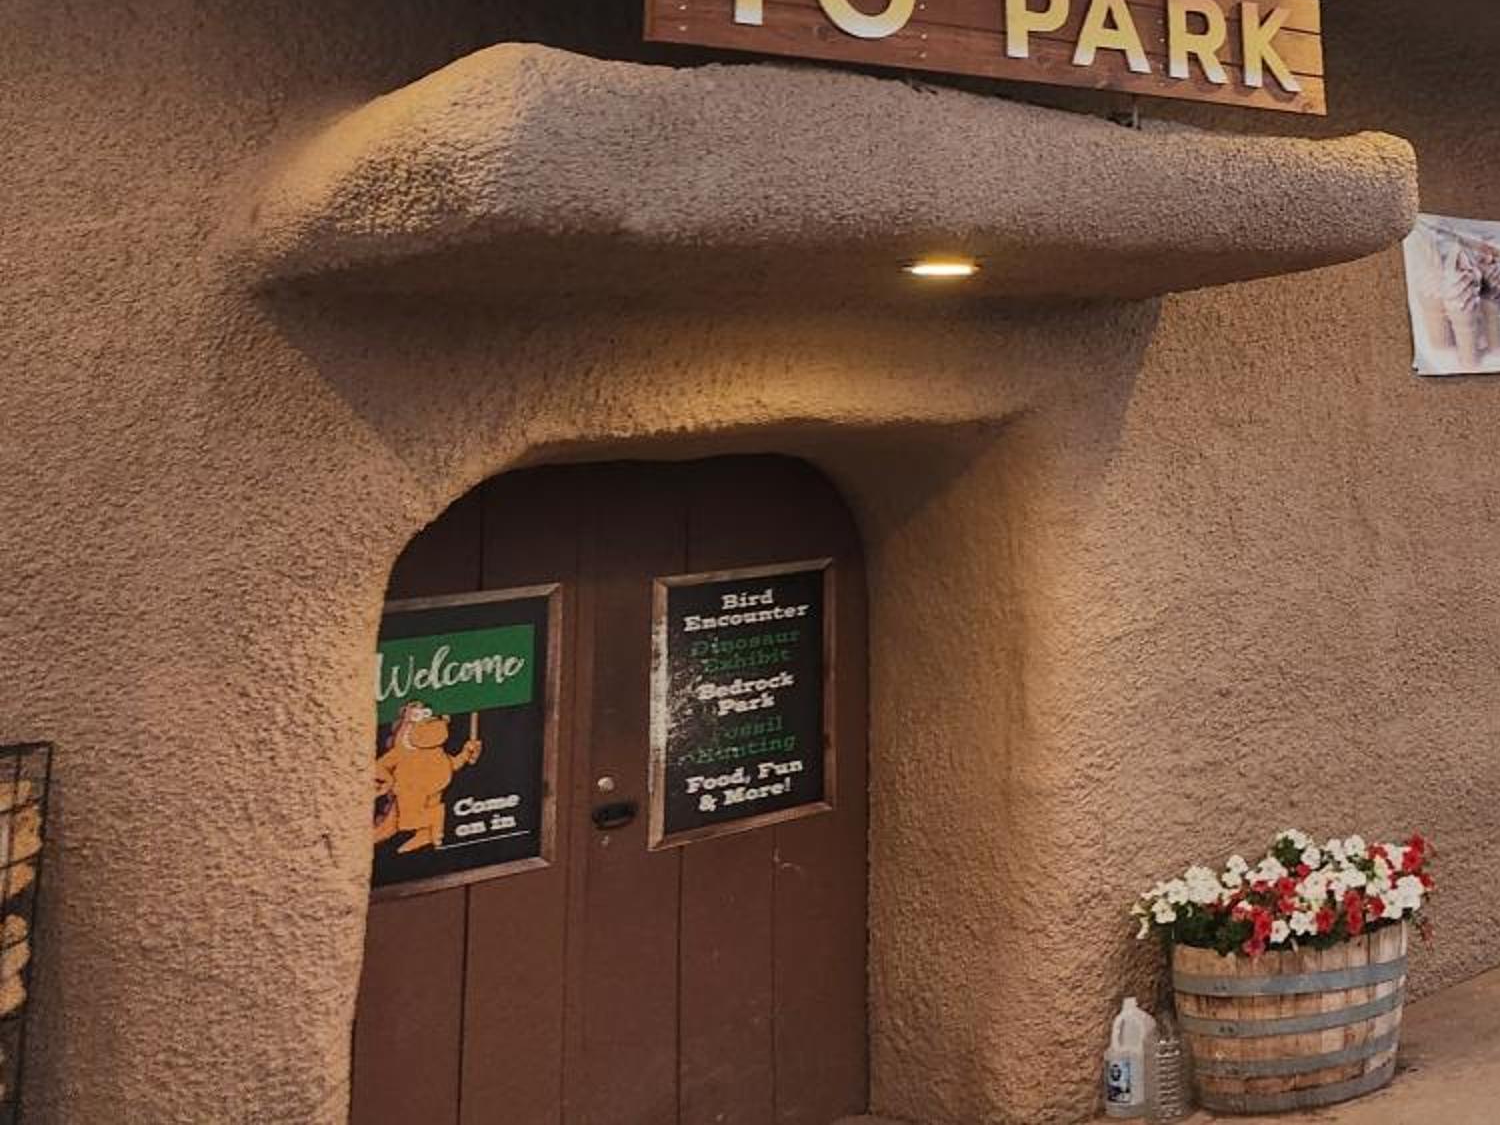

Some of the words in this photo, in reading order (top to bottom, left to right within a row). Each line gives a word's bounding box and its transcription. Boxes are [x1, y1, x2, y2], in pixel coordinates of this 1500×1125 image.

[721, 588, 774, 610] Bird
[683, 604, 811, 632] Encounter
[376, 645, 525, 702] Welcome
[696, 671, 795, 701] Bedrock
[717, 692, 775, 716] Park
[685, 767, 751, 794] Food,
[757, 760, 804, 780] Fun
[453, 794, 519, 817] Come
[699, 794, 718, 812] &
[722, 776, 792, 806] More!
[455, 820, 486, 837] on
[491, 814, 516, 831] in
